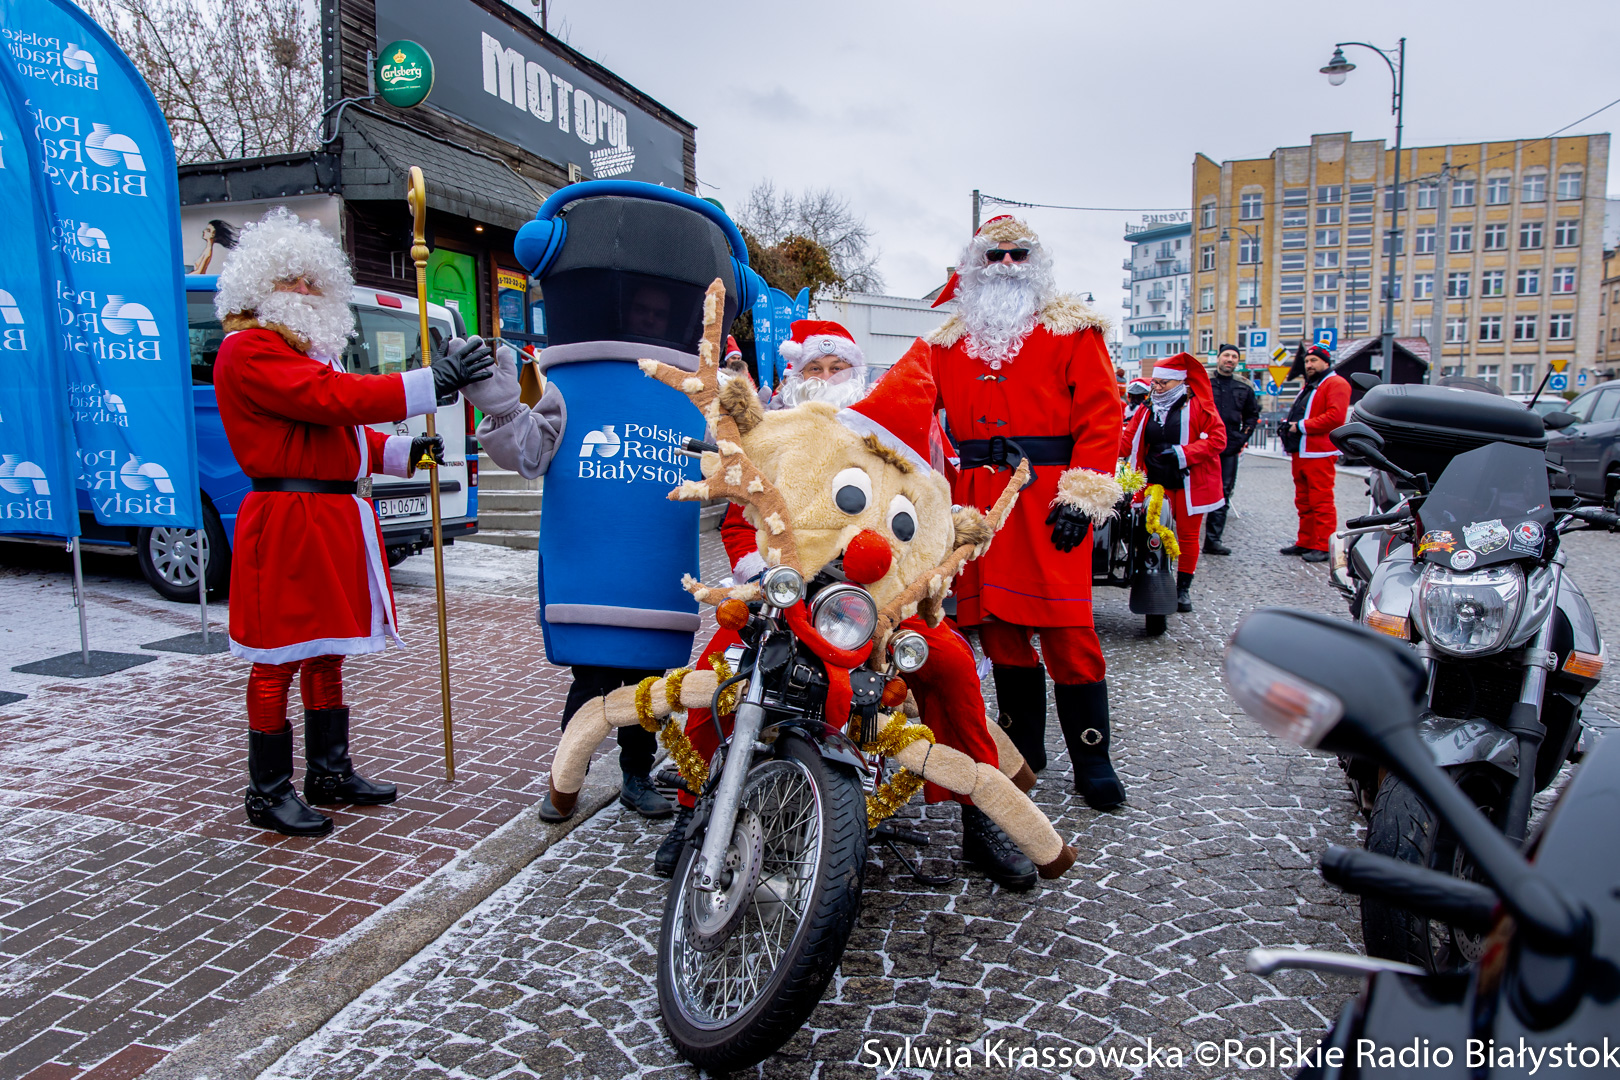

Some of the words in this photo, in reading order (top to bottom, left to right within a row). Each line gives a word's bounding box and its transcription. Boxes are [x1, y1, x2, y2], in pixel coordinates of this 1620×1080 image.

[381, 62, 422, 84] Carlsberg
[481, 31, 628, 152] MOTOPUB
[1253, 333, 1265, 346] P
[624, 423, 682, 446] Polski
[623, 440, 689, 468] Radio
[578, 459, 688, 486] Białystok
[380, 500, 393, 515] BI
[397, 497, 426, 513] 0677W
